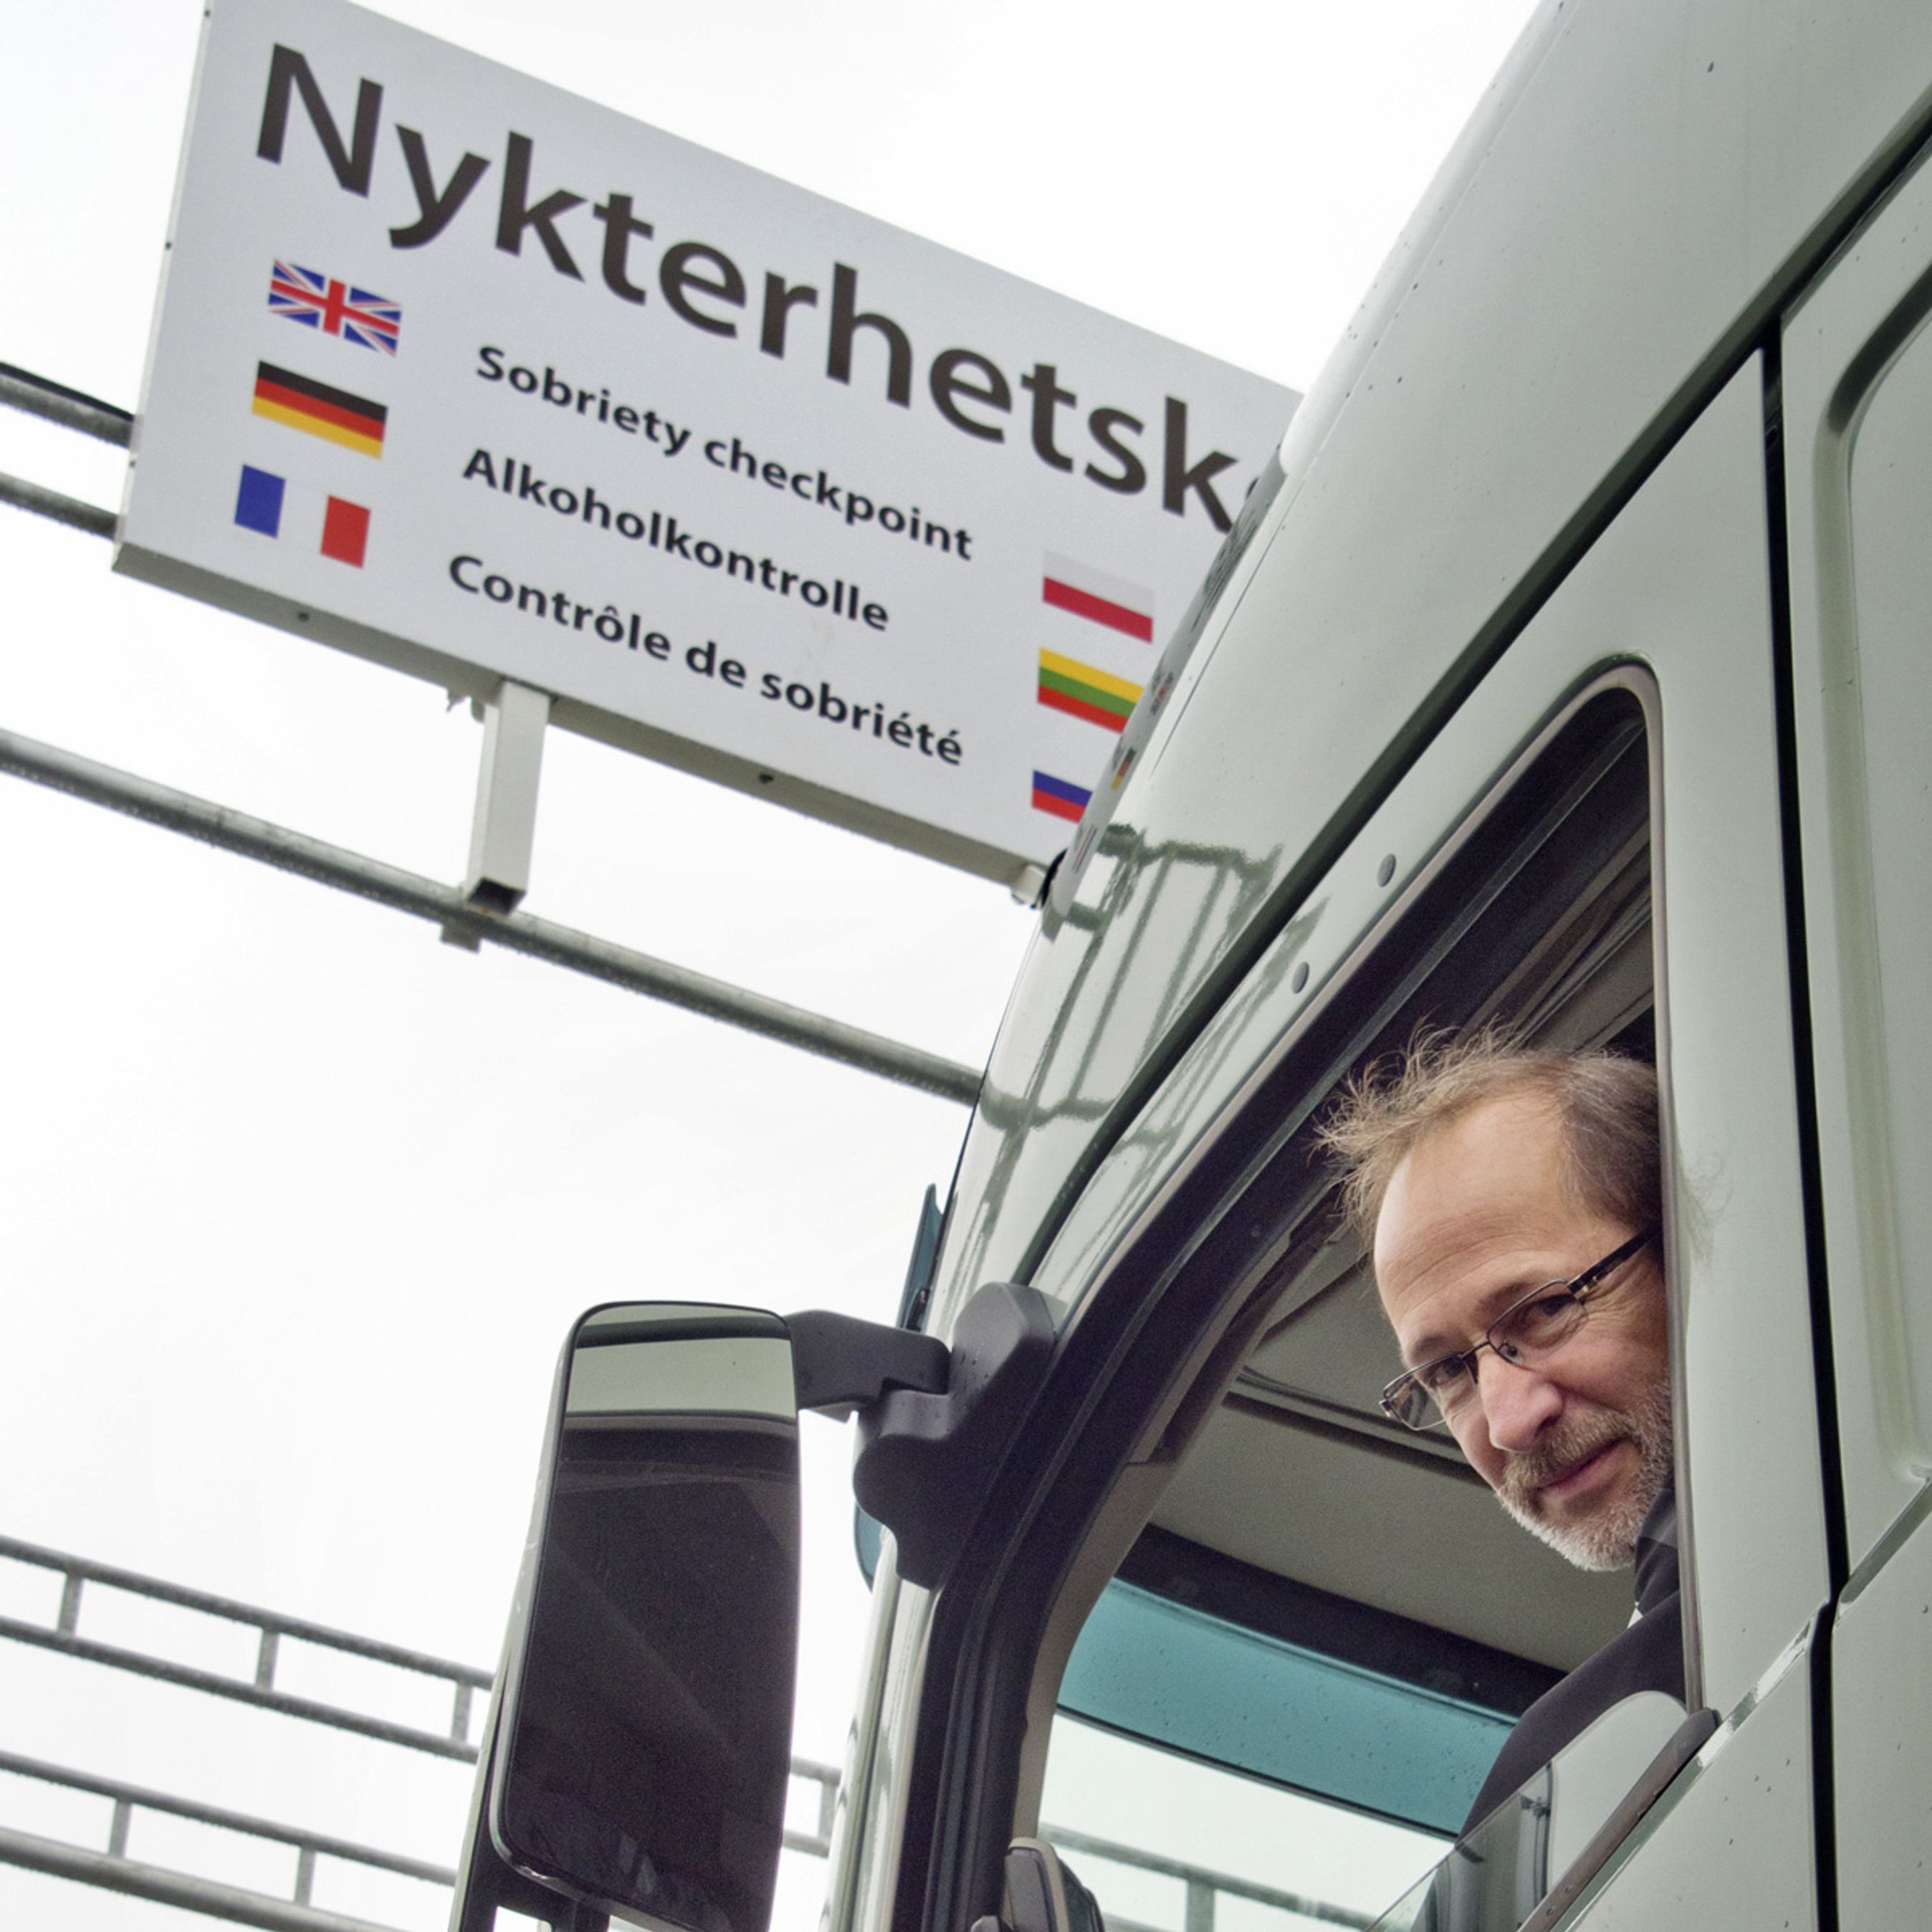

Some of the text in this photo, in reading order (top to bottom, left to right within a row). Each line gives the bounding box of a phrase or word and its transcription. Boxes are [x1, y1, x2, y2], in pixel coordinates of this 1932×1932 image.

[256, 42, 1259, 535] Nykterhetsk
[463, 448, 889, 631] Alkoholkontrolle
[477, 345, 972, 561] Sobriety checkpoint
[449, 555, 963, 766] Contrôle de sobriété
